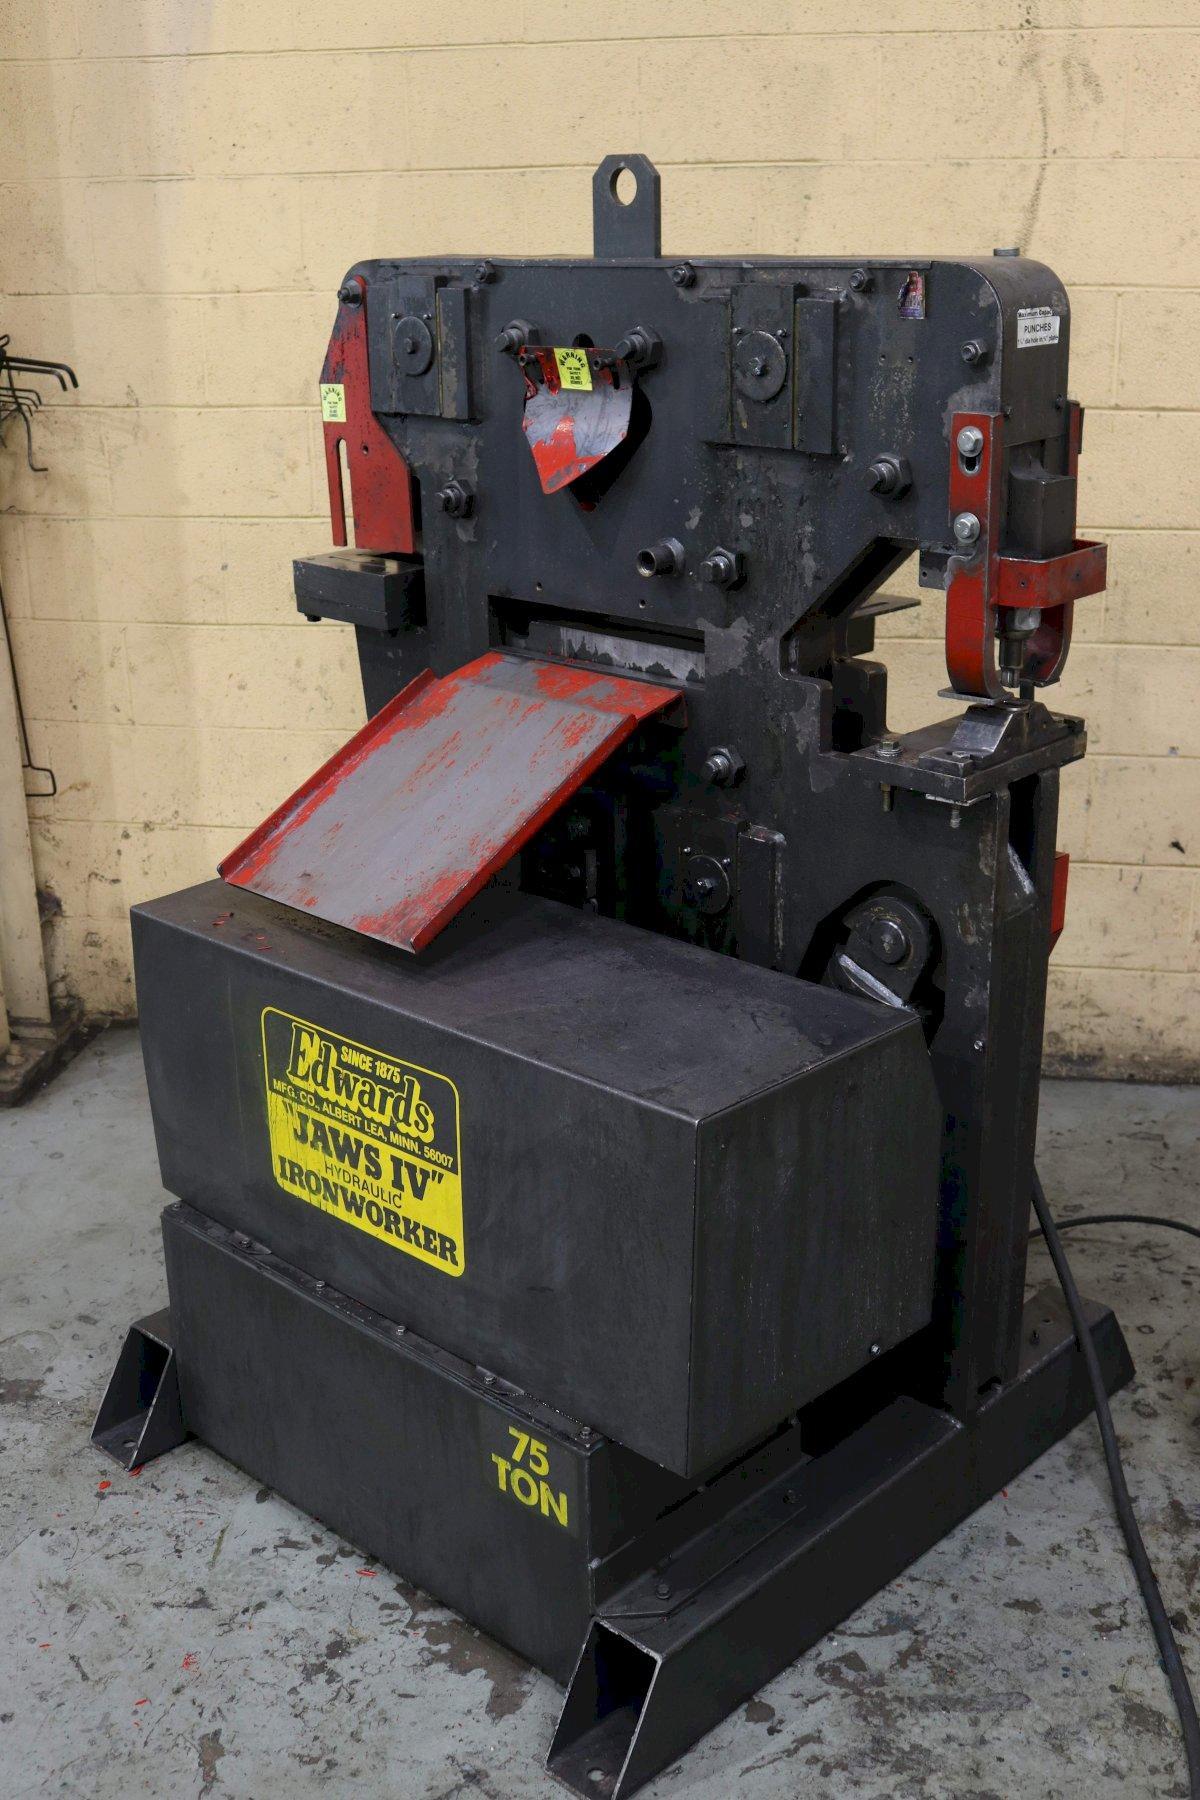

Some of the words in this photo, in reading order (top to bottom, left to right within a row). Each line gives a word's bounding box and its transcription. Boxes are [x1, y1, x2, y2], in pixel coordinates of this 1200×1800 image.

[1024, 322, 1052, 334] PUNCHES
[559, 351, 585, 368] WARNING
[286, 1022, 435, 1143] Edwards
[340, 1046, 373, 1073] SINCE
[375, 1060, 401, 1084] 1875
[273, 1078, 298, 1100] MFG.
[299, 1090, 320, 1111] CO.,
[322, 1101, 362, 1128] ALBERT
[364, 1118, 387, 1143] LEA,
[389, 1130, 422, 1155] MINN.
[423, 1147, 454, 1168] 56007
[324, 1160, 402, 1209] HYDRAULIC
[278, 1155, 460, 1267] IRONWORKER
[508, 1425, 550, 1476] 75
[491, 1452, 568, 1528] TON
